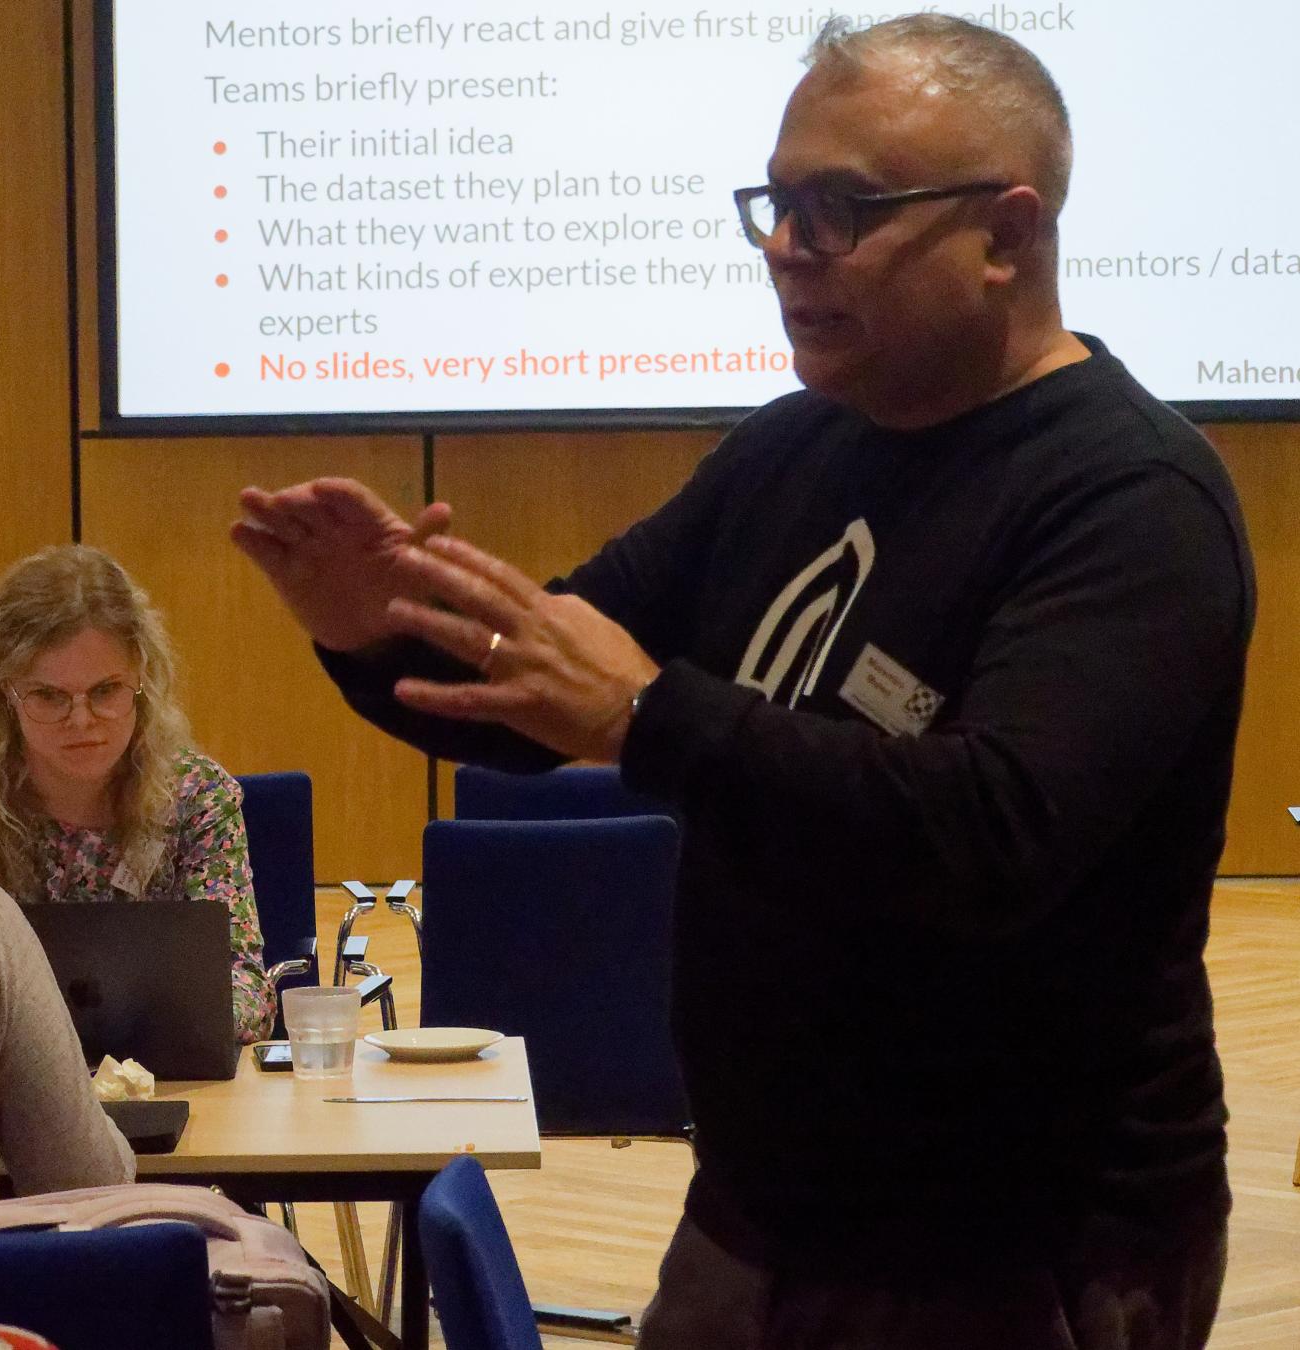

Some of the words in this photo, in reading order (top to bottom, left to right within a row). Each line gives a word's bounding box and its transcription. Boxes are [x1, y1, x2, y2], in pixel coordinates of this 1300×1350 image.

[206, 21, 341, 49] Mentors
[352, 17, 453, 50] briefly
[464, 17, 544, 43] react
[554, 13, 610, 41] and
[621, 13, 684, 47] give
[694, 11, 757, 38] first
[204, 77, 305, 105] Teams
[316, 73, 417, 106] briefly
[428, 73, 560, 105] present:
[257, 131, 341, 160] Their
[351, 129, 436, 158] initial
[450, 128, 513, 155] idea
[257, 176, 316, 204] The
[327, 175, 444, 202] dataset
[455, 172, 523, 205] they
[534, 171, 599, 205] plan
[610, 172, 641, 197] to
[652, 176, 704, 196] use
[258, 220, 346, 247] What
[356, 218, 425, 252] they
[434, 218, 513, 244] want
[524, 217, 555, 242] to
[565, 214, 683, 248] explore
[693, 220, 725, 239] or
[258, 265, 346, 292] What
[358, 263, 439, 291] kinds
[449, 261, 480, 289] of
[489, 259, 636, 294] expertise
[646, 258, 716, 291] they
[1067, 252, 1200, 278] mentors
[1209, 249, 1222, 278] /
[1231, 248, 1300, 276] data
[259, 310, 377, 342] experts
[261, 355, 307, 381] No
[316, 353, 413, 382] slides,
[424, 358, 495, 384] very
[504, 350, 589, 377] short
[599, 345, 795, 382] presentatio
